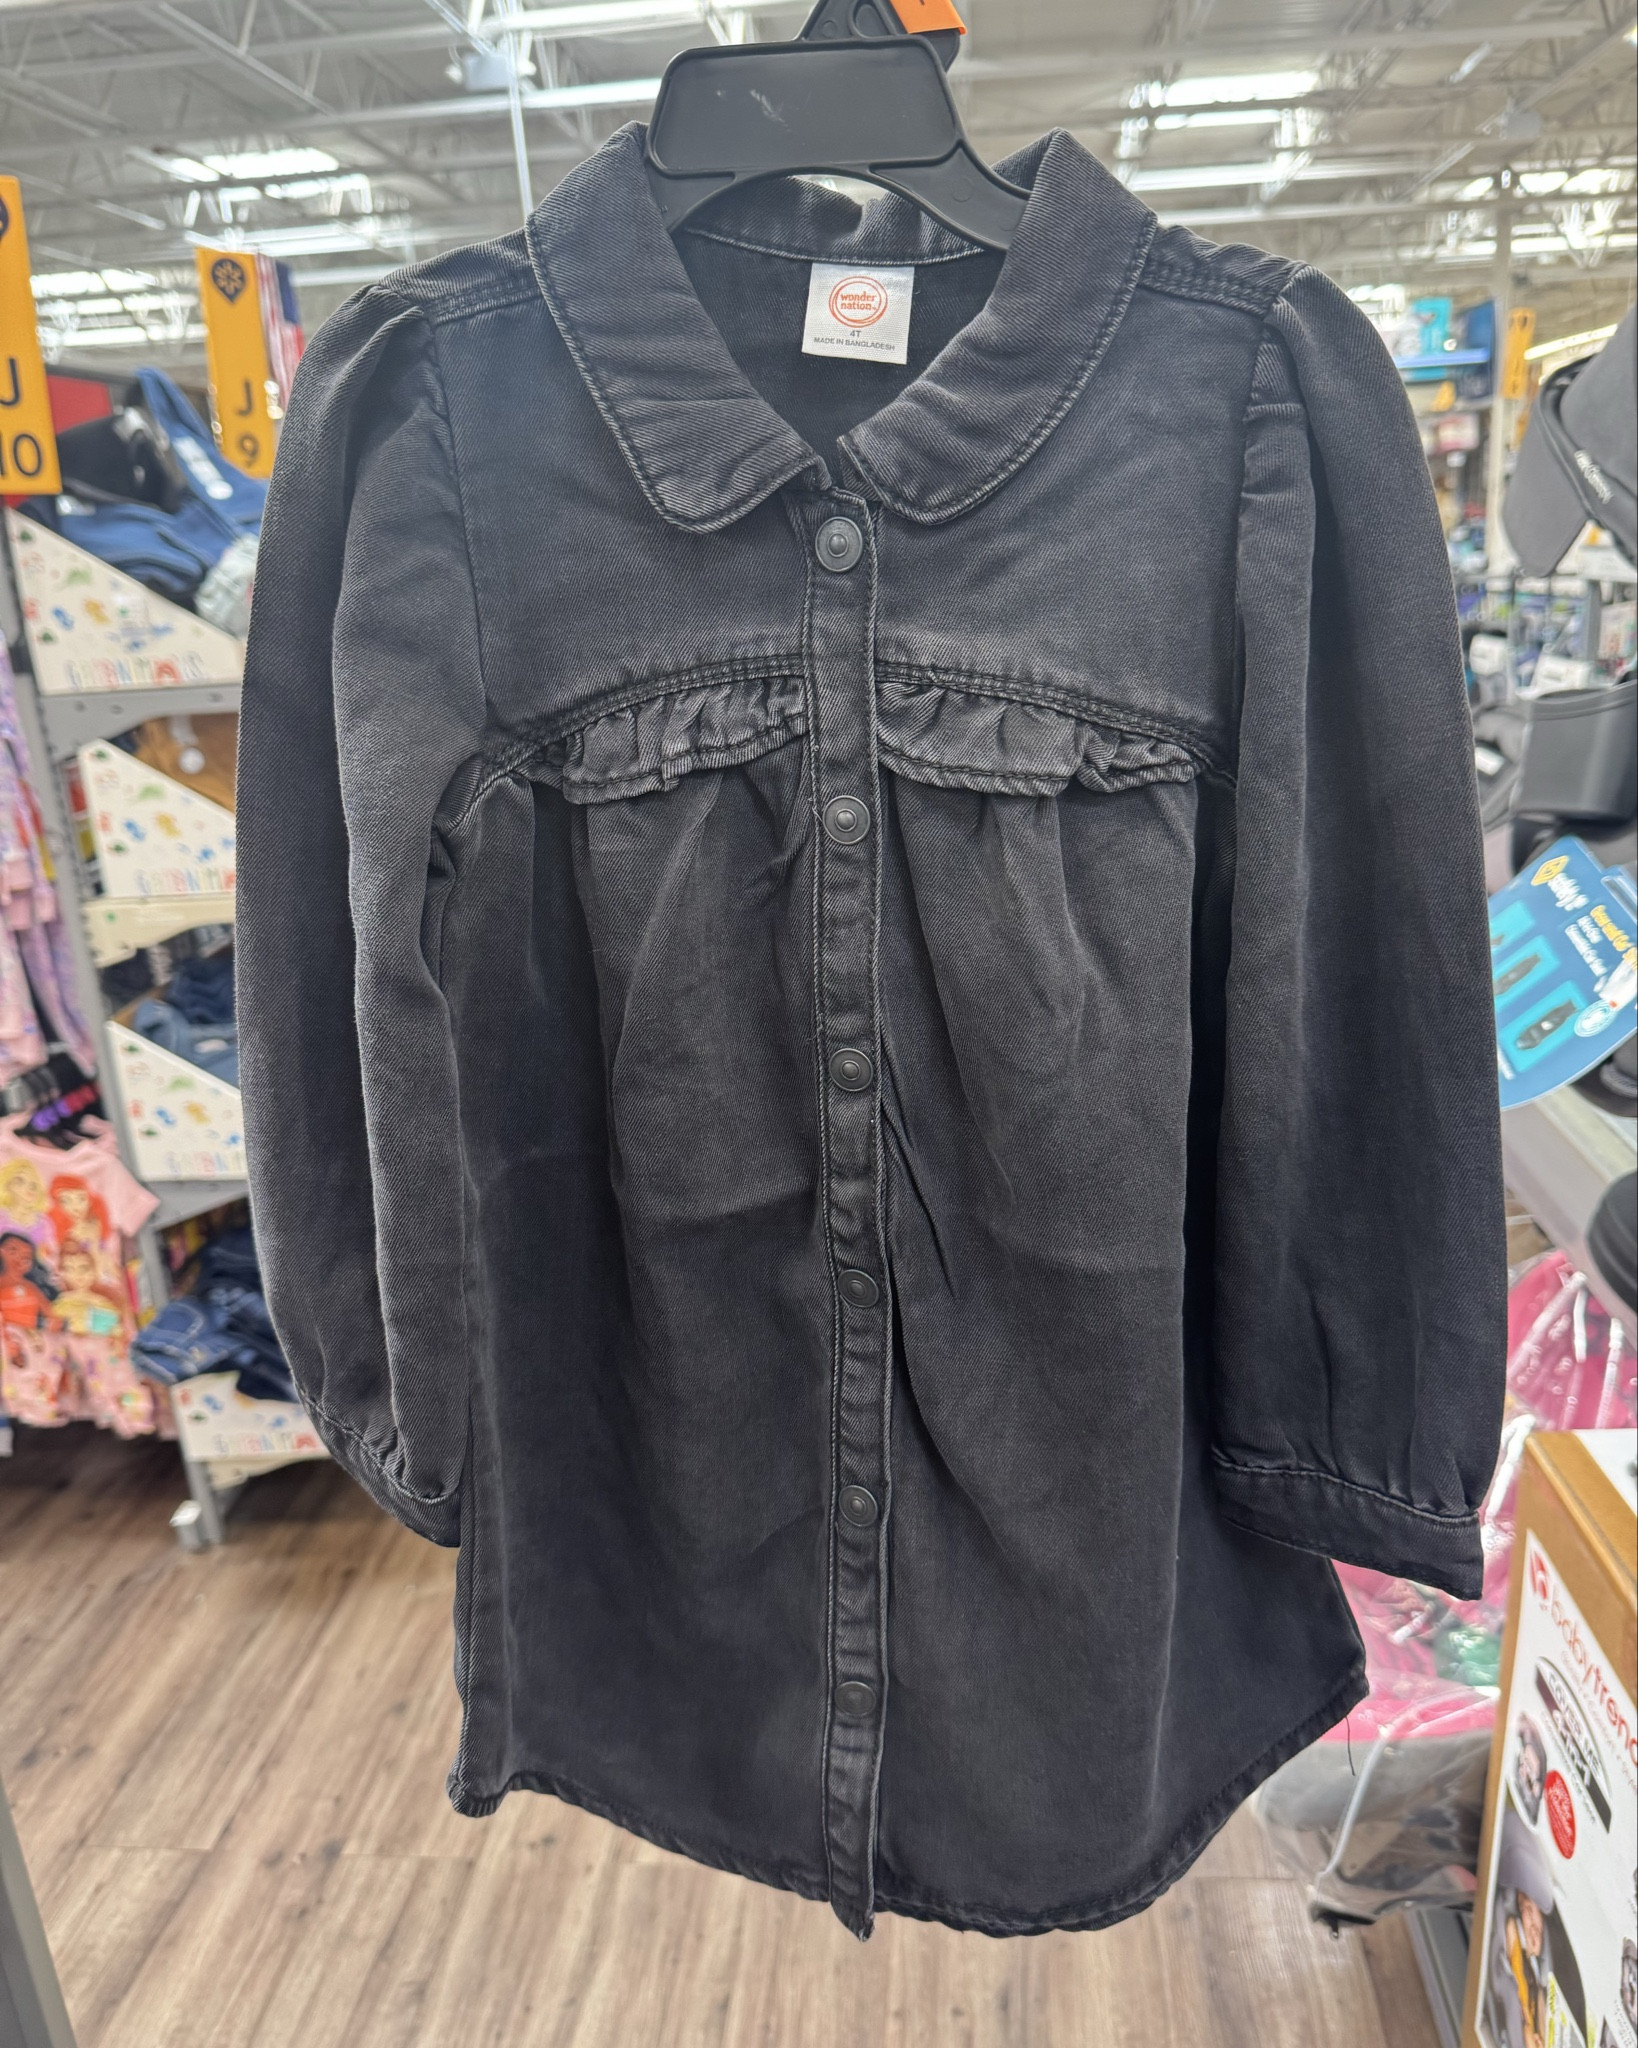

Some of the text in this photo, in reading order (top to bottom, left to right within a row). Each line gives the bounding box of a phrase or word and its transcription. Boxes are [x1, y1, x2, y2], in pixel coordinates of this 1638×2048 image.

[841, 291, 877, 302] wonder
[841, 301, 873, 311] nation
[814, 337, 835, 345] MADE
[845, 339, 895, 351] BANGLADESH
[0, 358, 20, 406] J
[238, 380, 253, 416] J
[238, 434, 260, 467] 9
